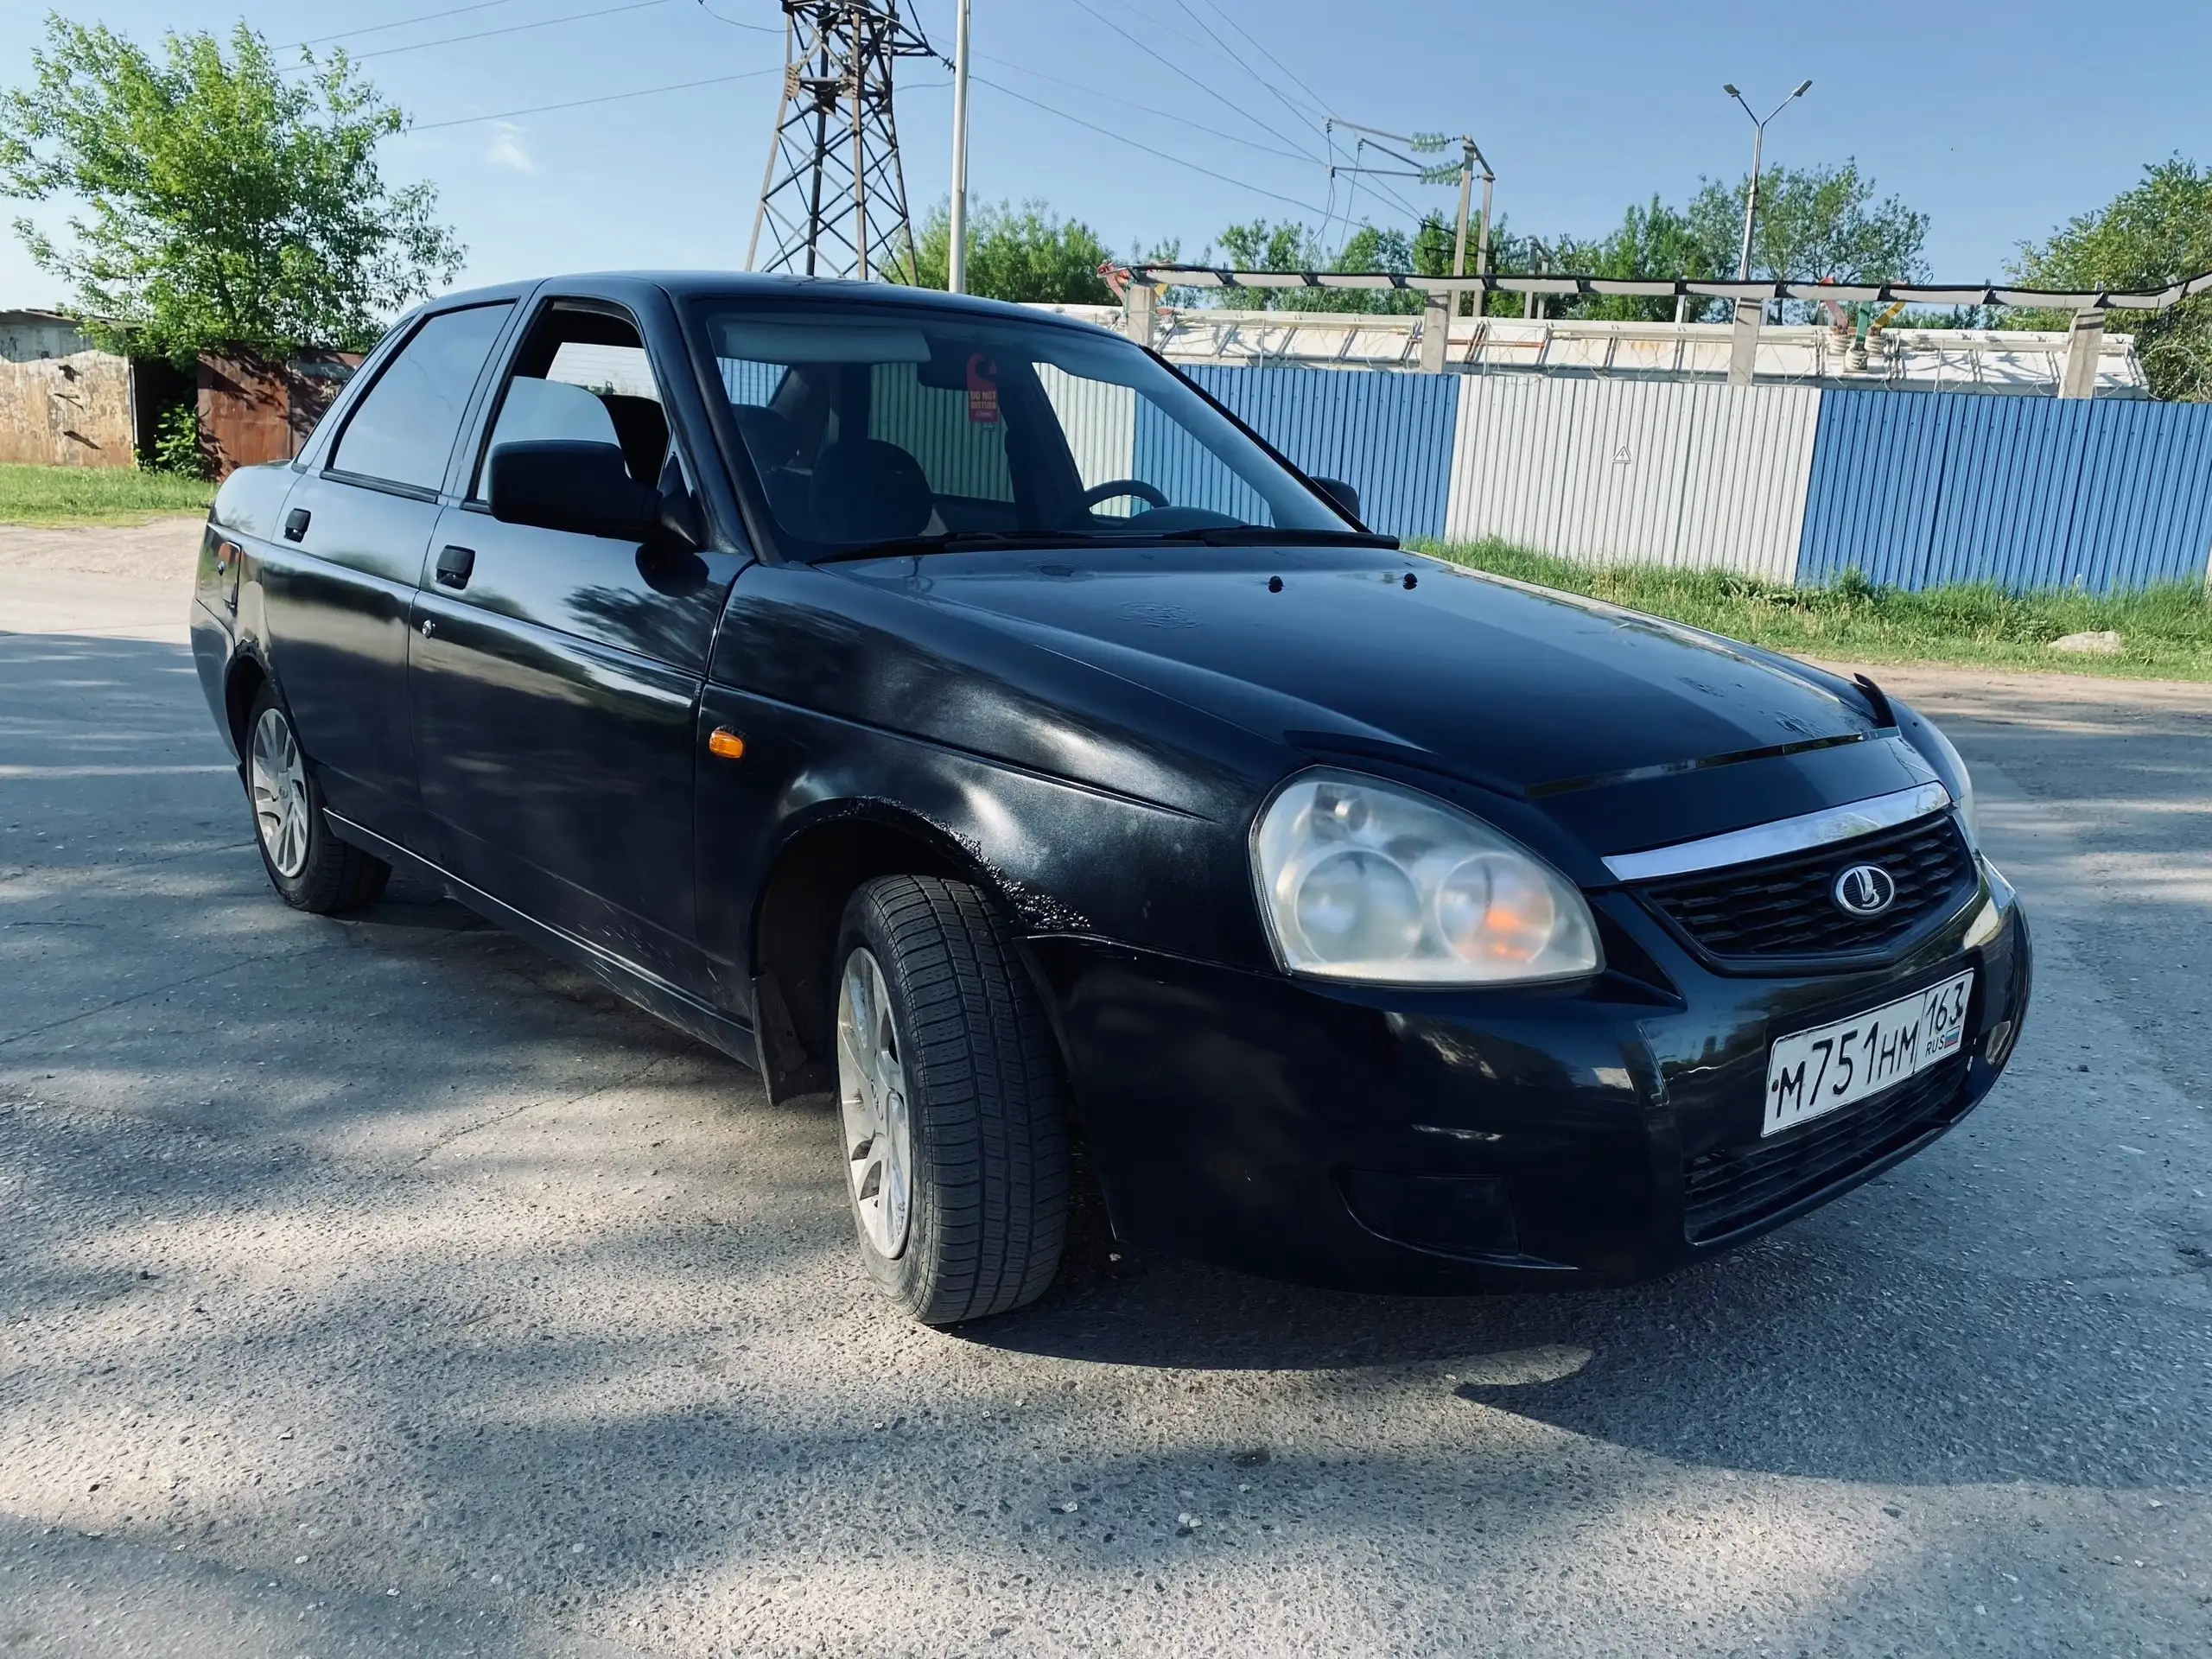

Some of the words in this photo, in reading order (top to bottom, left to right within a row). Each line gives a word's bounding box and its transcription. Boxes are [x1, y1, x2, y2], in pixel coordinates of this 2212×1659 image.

[969, 391, 981, 400] DO
[982, 391, 996, 400] NOT
[1926, 981, 1965, 1037] 163
[1924, 1034, 1945, 1058] RUS
